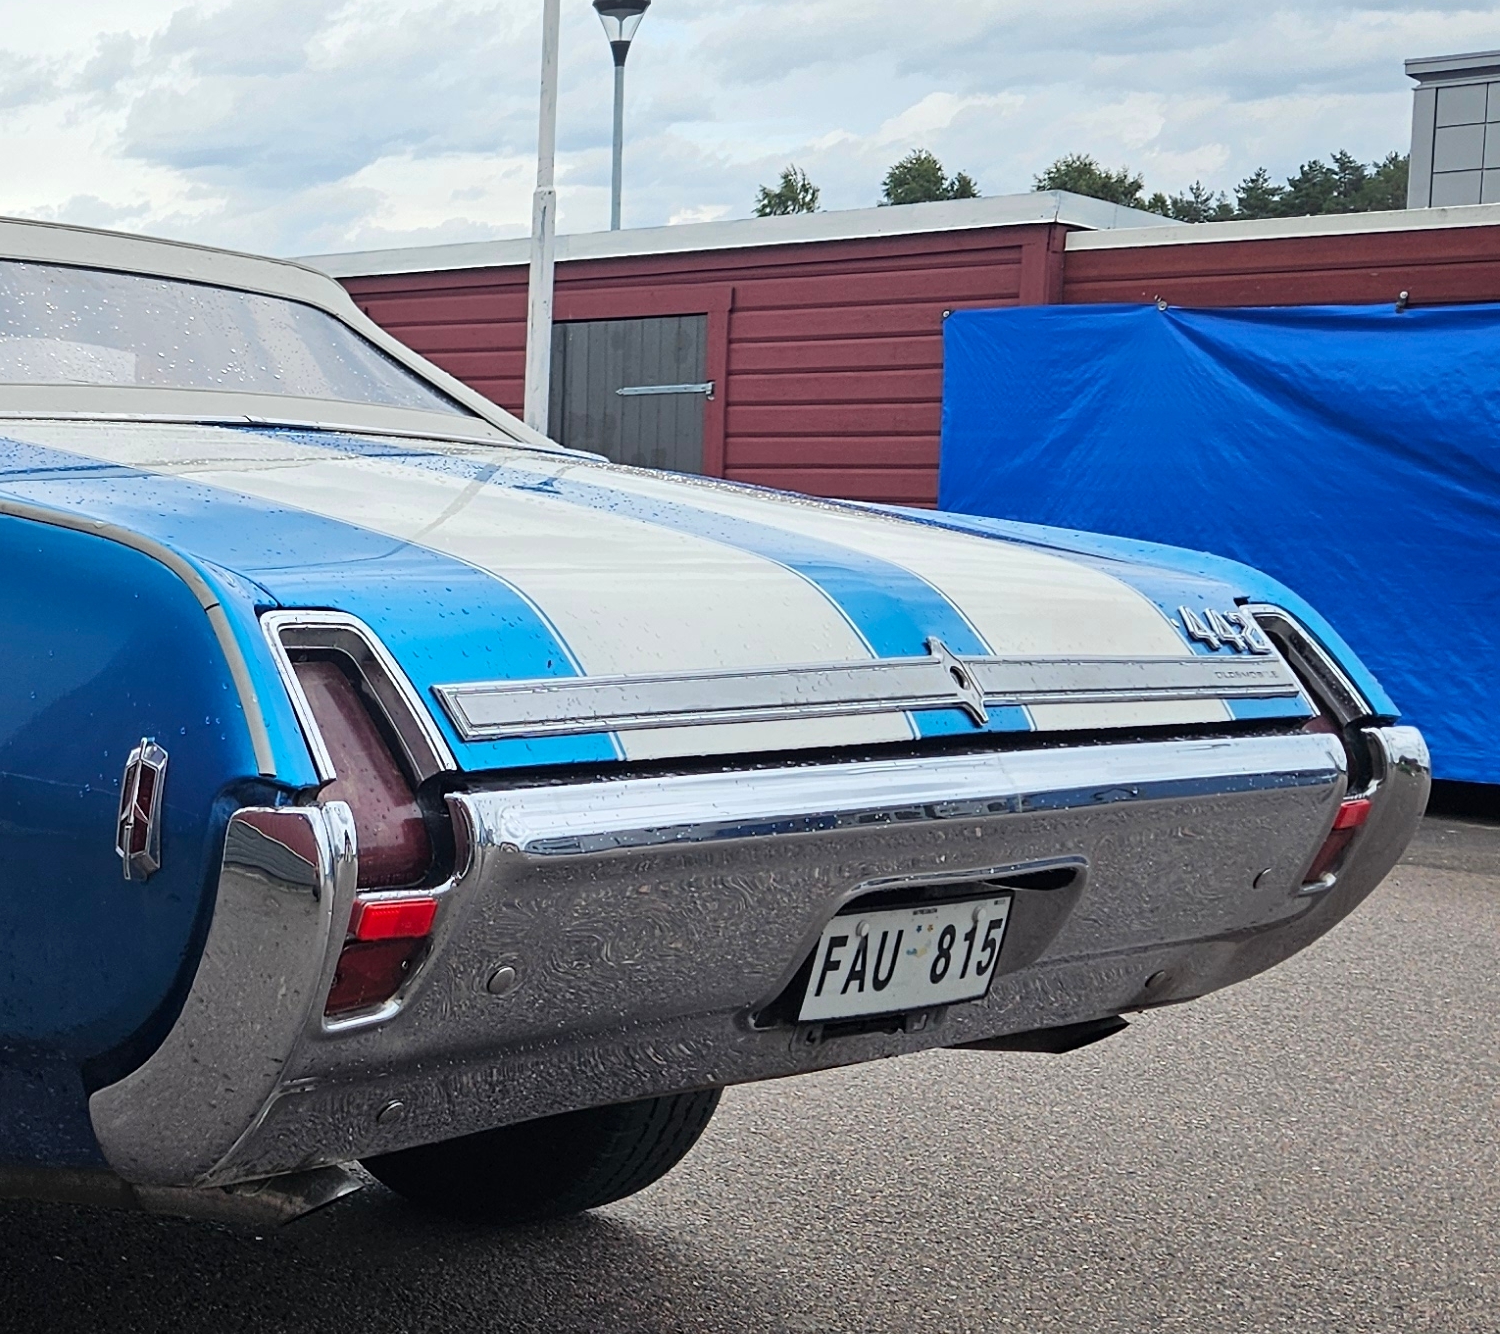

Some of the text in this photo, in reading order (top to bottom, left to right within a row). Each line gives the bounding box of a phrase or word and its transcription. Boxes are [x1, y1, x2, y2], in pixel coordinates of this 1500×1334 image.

[1177, 604, 1271, 654] 442
[814, 918, 1003, 997] FAU 815
